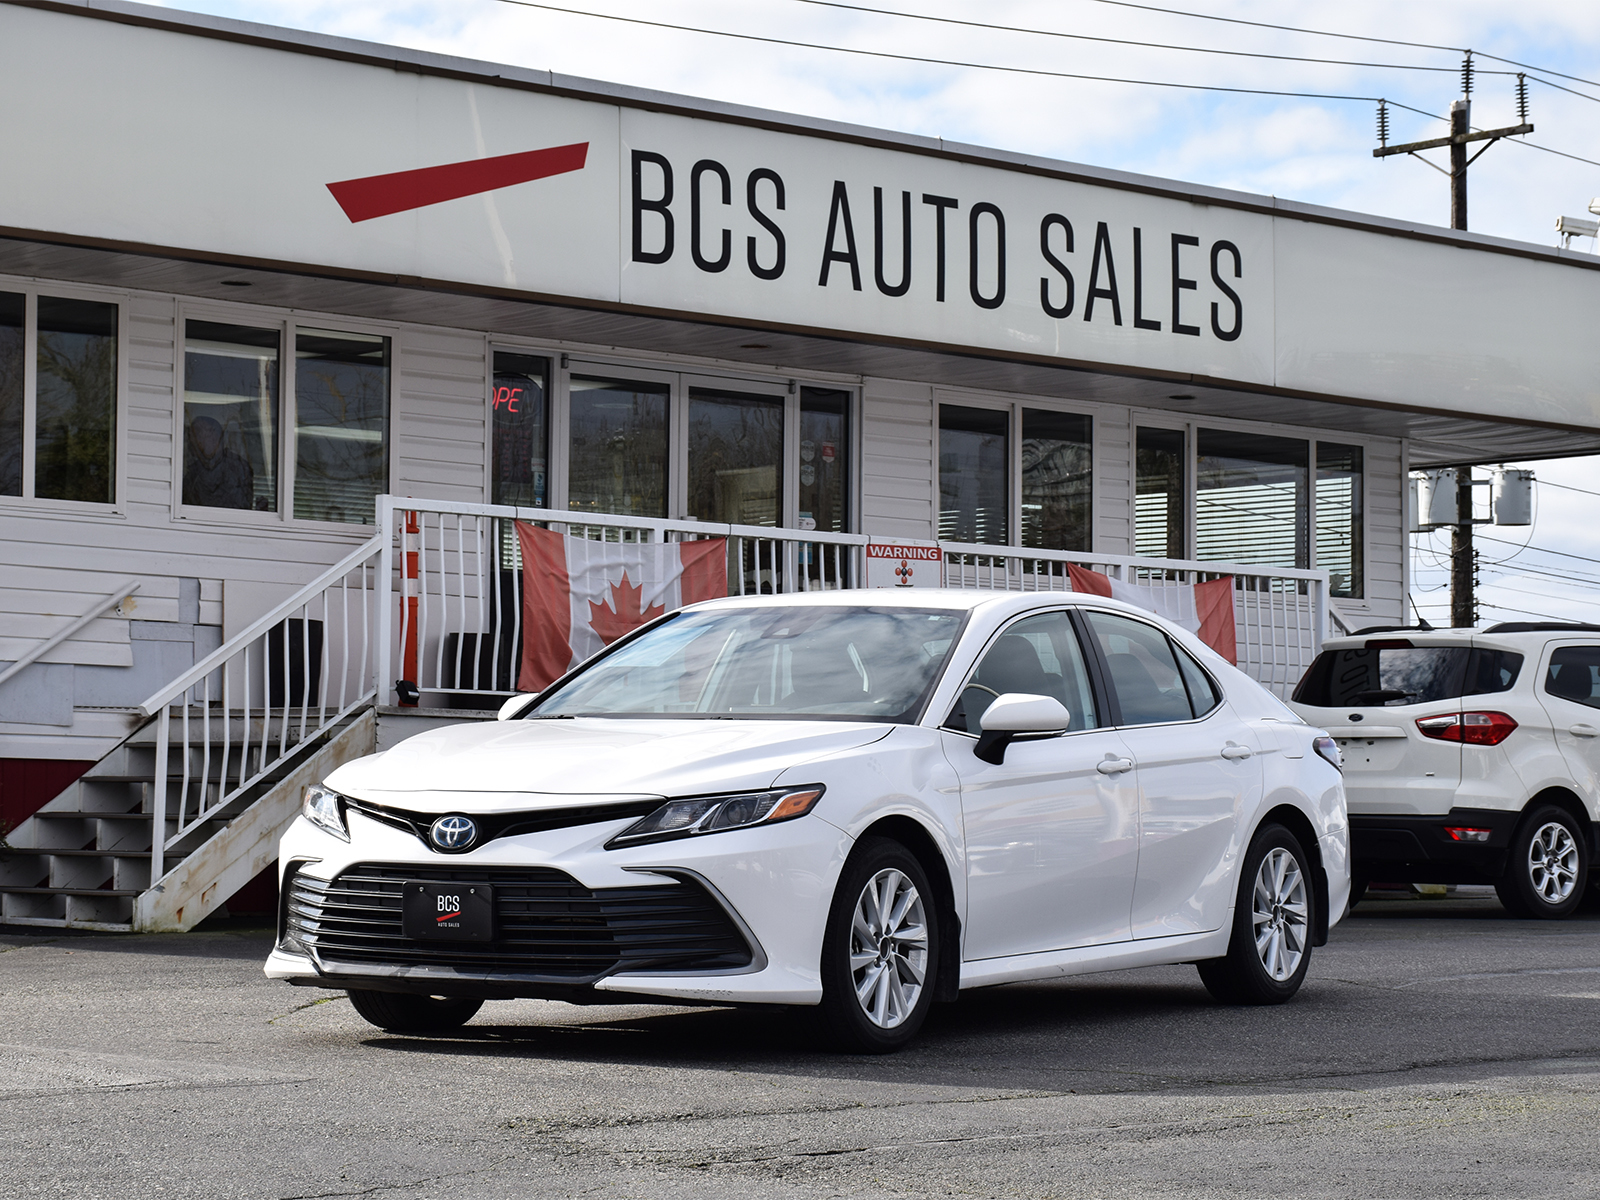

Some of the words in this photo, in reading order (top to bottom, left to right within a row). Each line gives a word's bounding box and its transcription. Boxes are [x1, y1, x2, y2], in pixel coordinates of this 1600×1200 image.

[631, 149, 786, 281] BCS
[818, 180, 1006, 309] AUTO
[1040, 213, 1243, 342] SALES
[869, 545, 938, 560] WARNING
[437, 895, 460, 912] BCS
